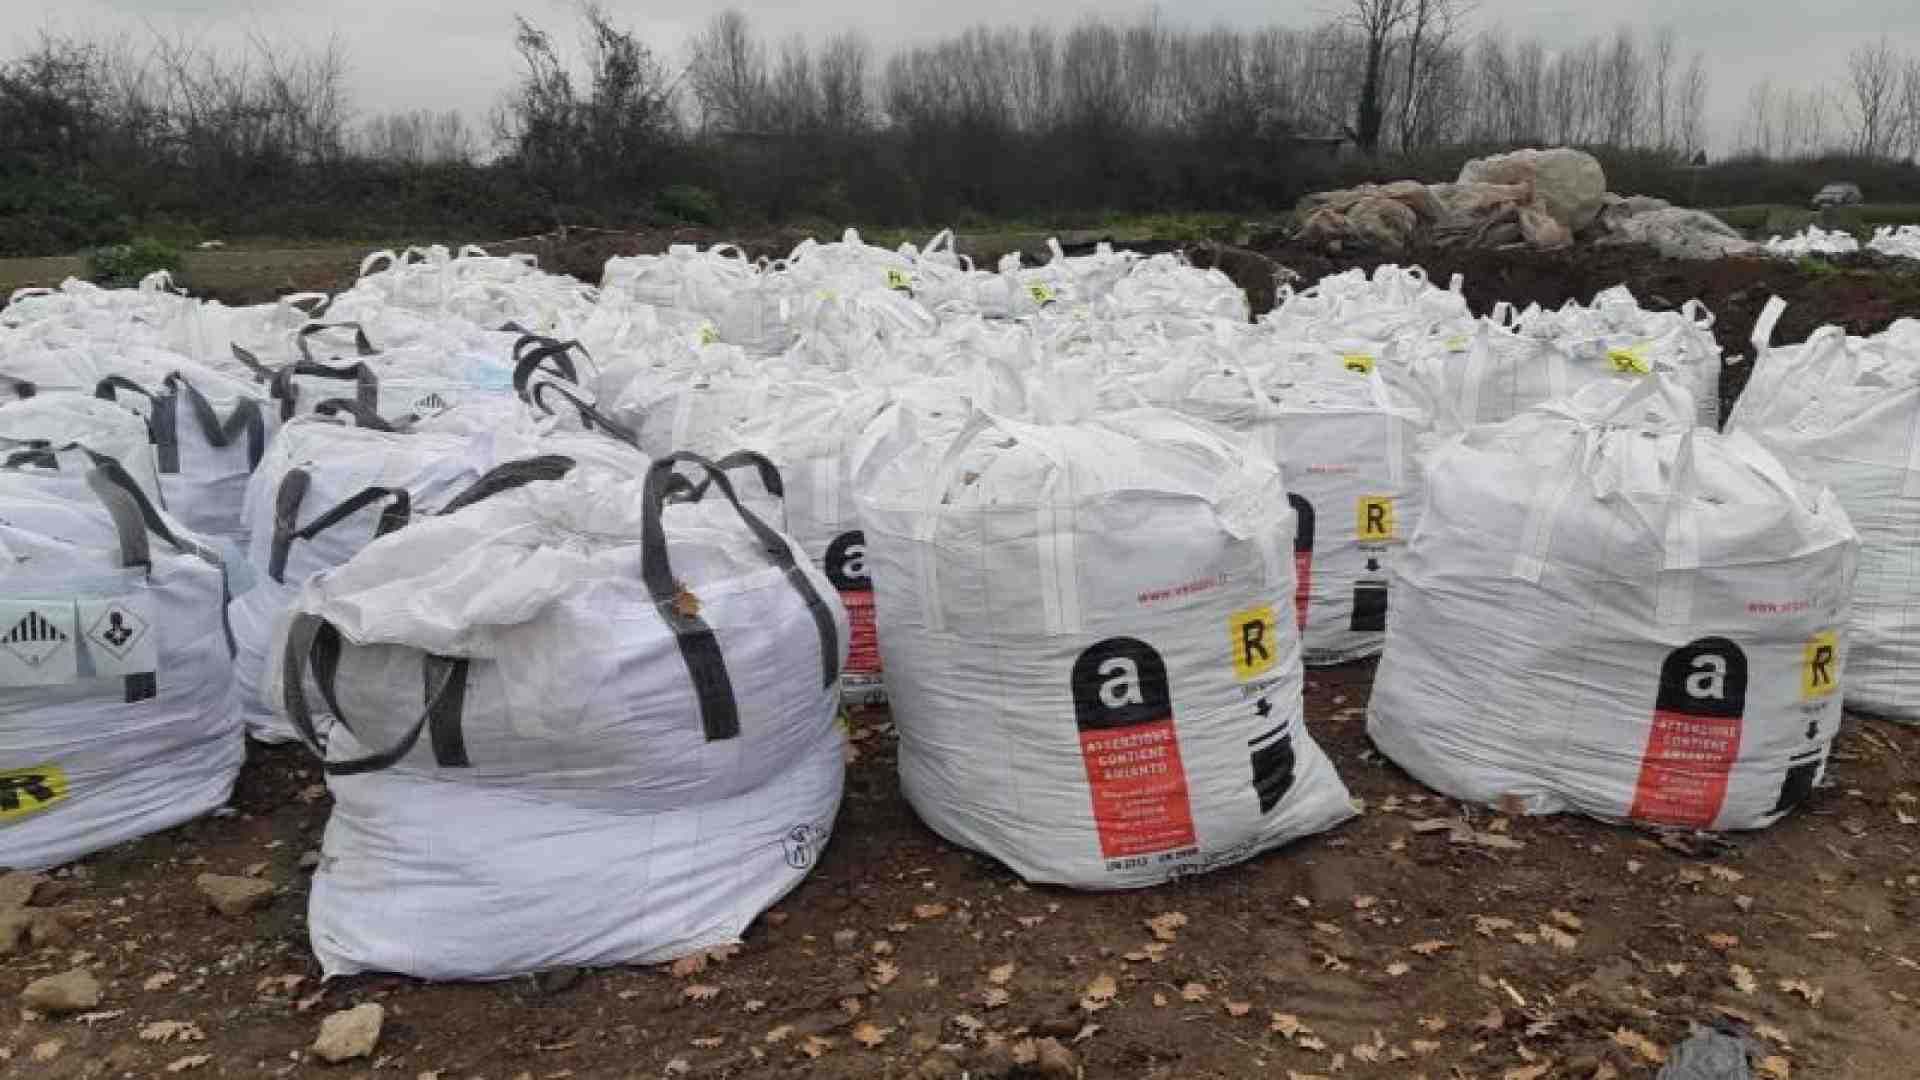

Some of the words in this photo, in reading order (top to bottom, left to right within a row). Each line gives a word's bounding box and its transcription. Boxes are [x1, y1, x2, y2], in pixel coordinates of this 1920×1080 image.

[1367, 503, 1386, 534] R
[842, 544, 865, 578] a
[1242, 618, 1269, 667] R
[1097, 656, 1144, 708] a
[1686, 654, 1725, 700] a
[1811, 645, 1833, 687] R
[1086, 729, 1171, 753] ATTENZIONE
[1098, 746, 1168, 767] CONTIENE
